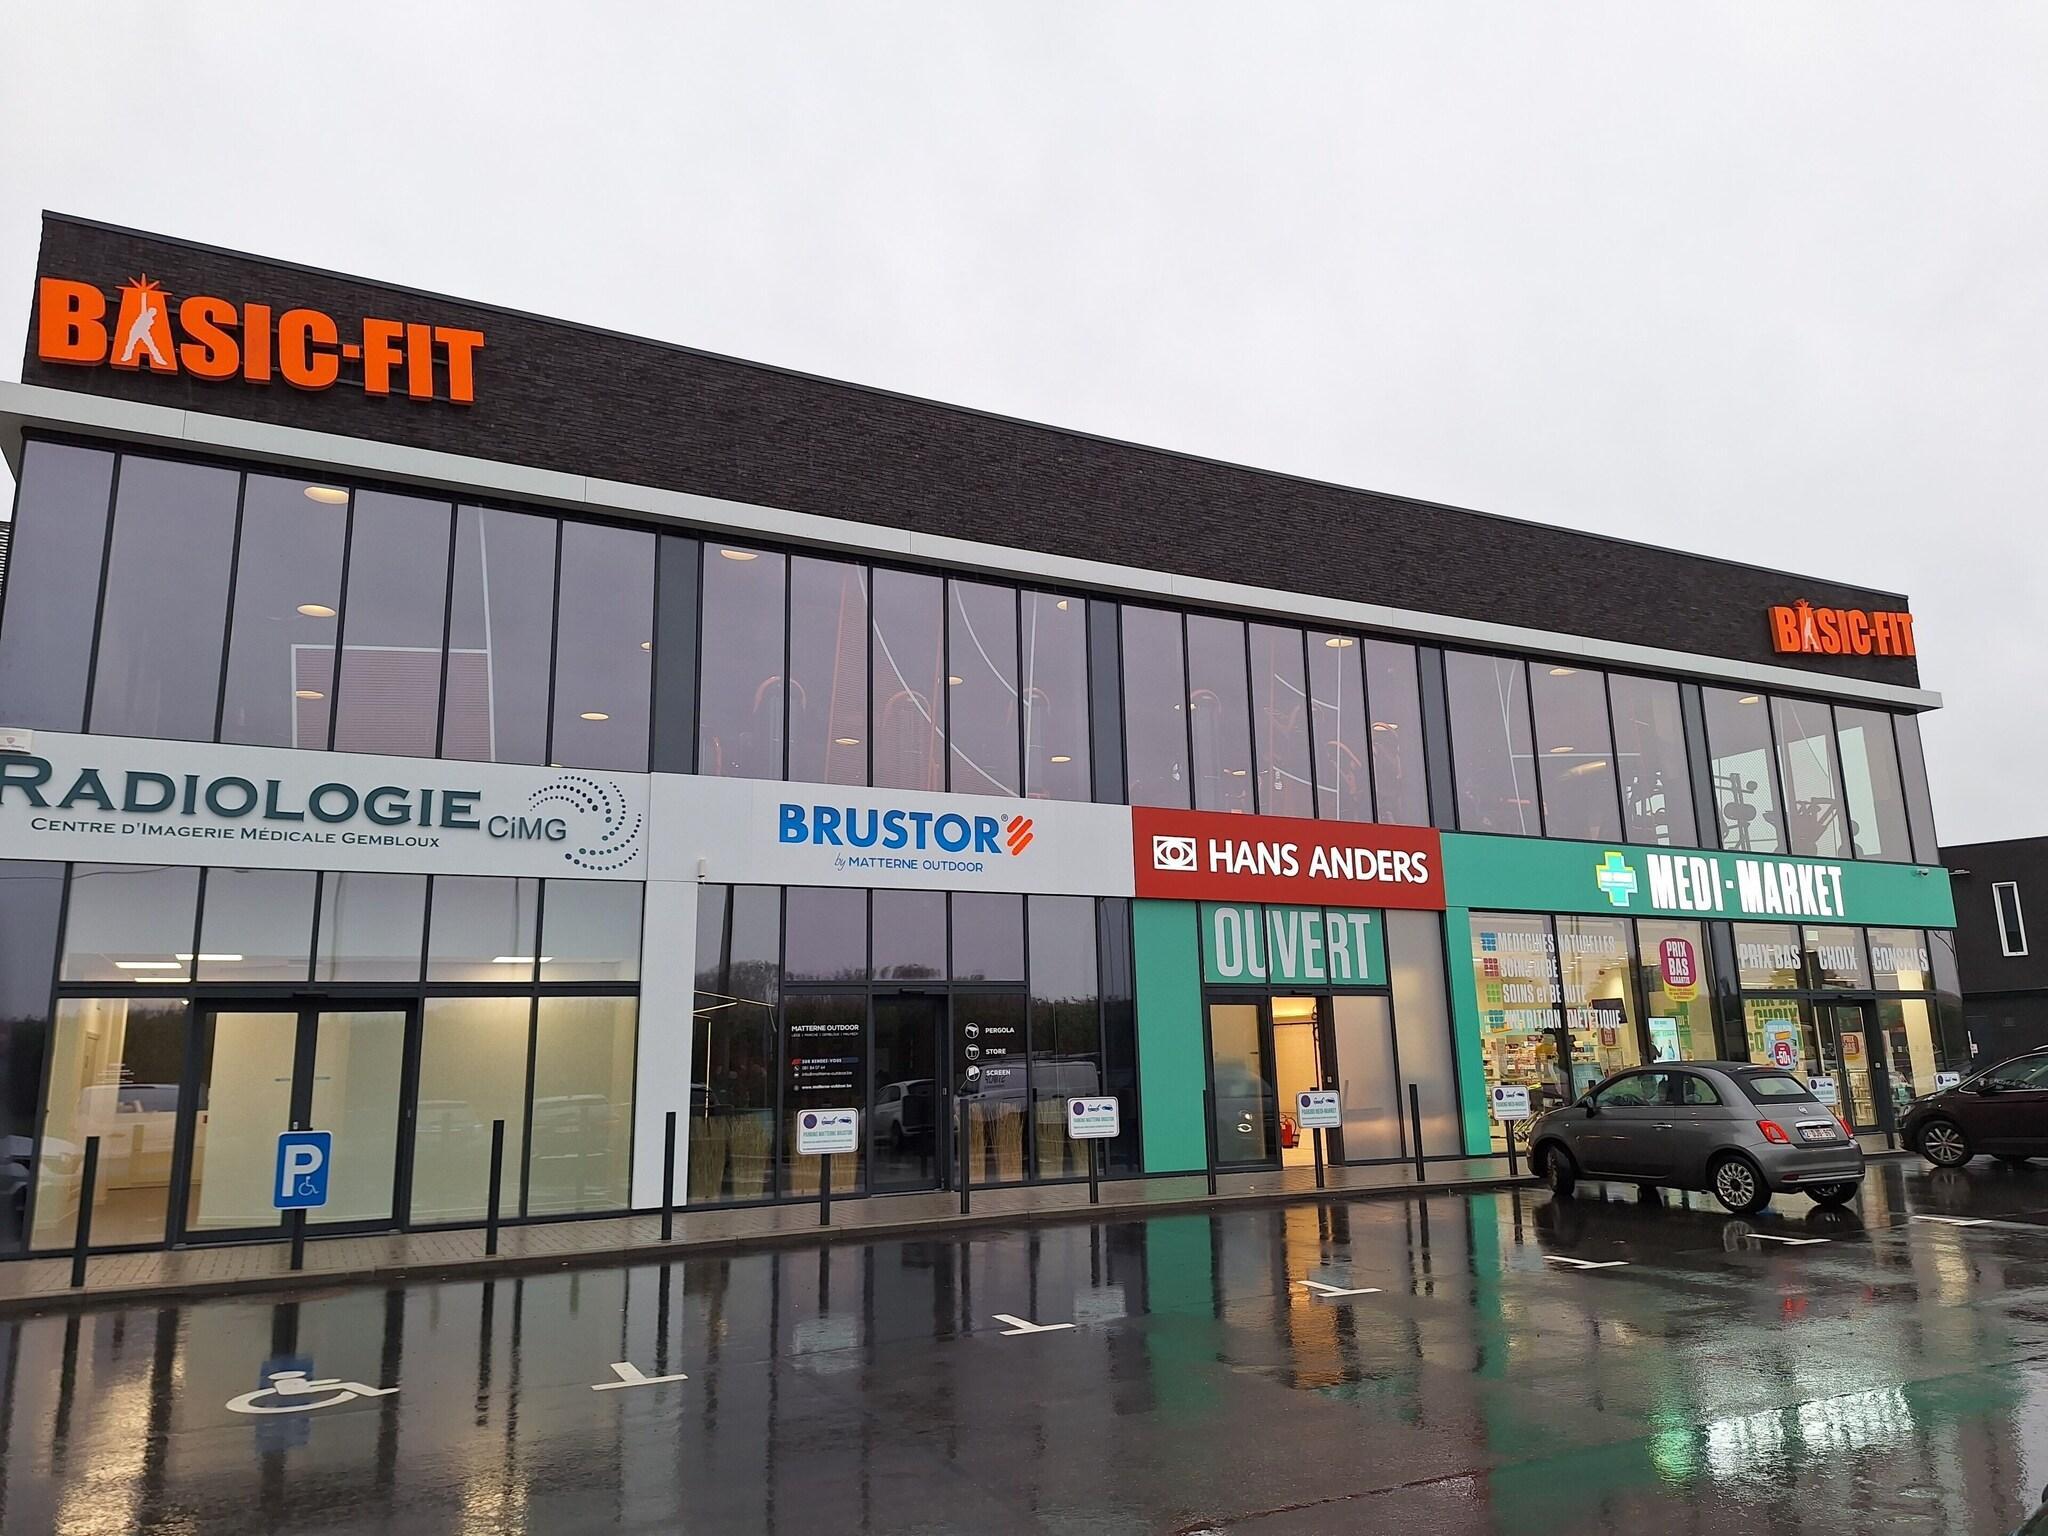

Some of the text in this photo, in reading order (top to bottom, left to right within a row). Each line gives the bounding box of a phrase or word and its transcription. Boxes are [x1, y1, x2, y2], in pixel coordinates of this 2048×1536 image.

[38, 273, 485, 406] BASIC-FIT
[1768, 599, 1917, 656] BASIC-FIT
[0, 755, 567, 841] RADIOLOGIE CiMG
[31, 818, 440, 848] CENTRE D'IMAGERIE MÉDICALE GEMBLOUX
[834, 852, 984, 873] by MATTERNE OUTDOOR
[1208, 838, 1429, 884] HANS ANDERS
[1213, 906, 1371, 980] OUVERT
[1665, 940, 1688, 958] PRIX
[1738, 943, 1801, 969] PRIX BAS
[1817, 945, 1859, 970] CHOIX
[1667, 957, 1690, 977] BAS
[1502, 983, 1534, 1004] SOINS
[1536, 985, 1548, 1004] et
[281, 1144, 323, 1197] P
